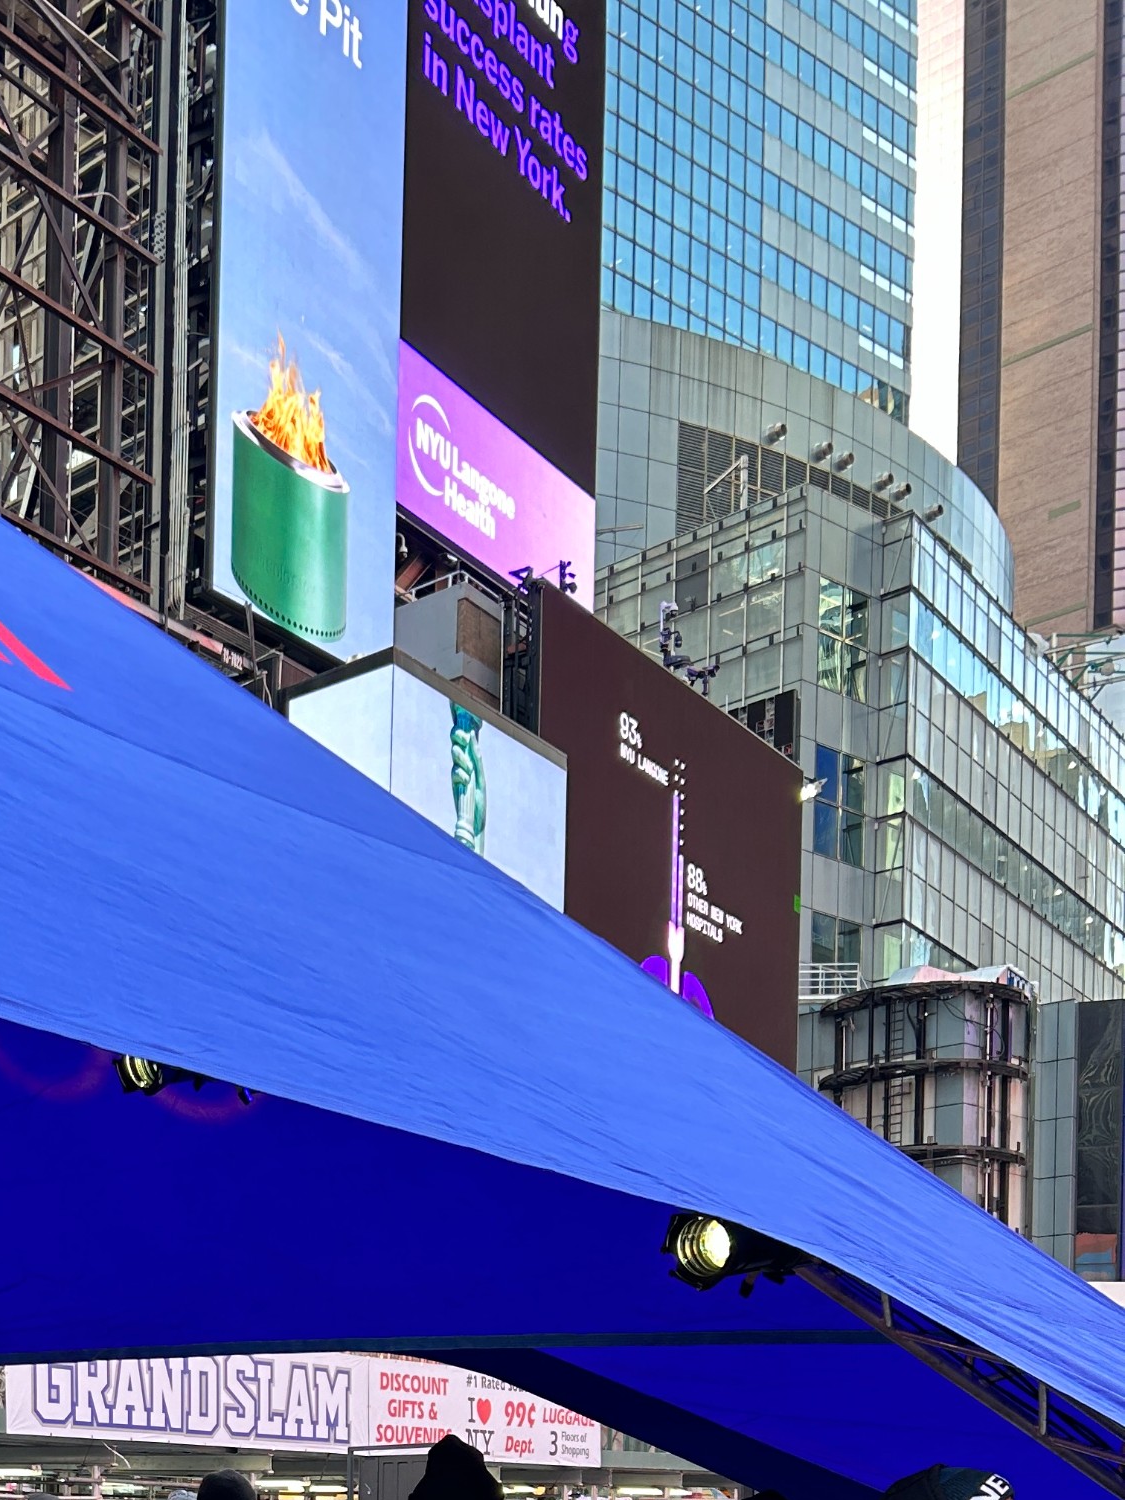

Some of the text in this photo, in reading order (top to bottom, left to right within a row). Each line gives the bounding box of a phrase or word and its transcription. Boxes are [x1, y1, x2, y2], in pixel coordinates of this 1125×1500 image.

[319, 0, 362, 69] Pit
[528, 0, 579, 64] ung
[424, 0, 588, 181] success rates
[424, 32, 572, 223] in New York.
[416, 417, 516, 520] NYU Langone
[444, 475, 496, 540] Health
[620, 742, 669, 786] NYU LANGONE
[686, 911, 724, 943] HOSPITALS
[687, 892, 743, 935] OTHER NEW YORK
[32, 1355, 351, 1444] GRAND SLAM
[379, 1371, 449, 1396] DISCOUNT
[466, 1374, 478, 1389] #1
[387, 1399, 437, 1420] GIFTS &
[504, 1400, 536, 1428] 99¢
[465, 1428, 494, 1455] NY
[505, 1435, 534, 1457] Dept.
[549, 1430, 588, 1456] 3 Floors of
[561, 1444, 590, 1458] Shopping
